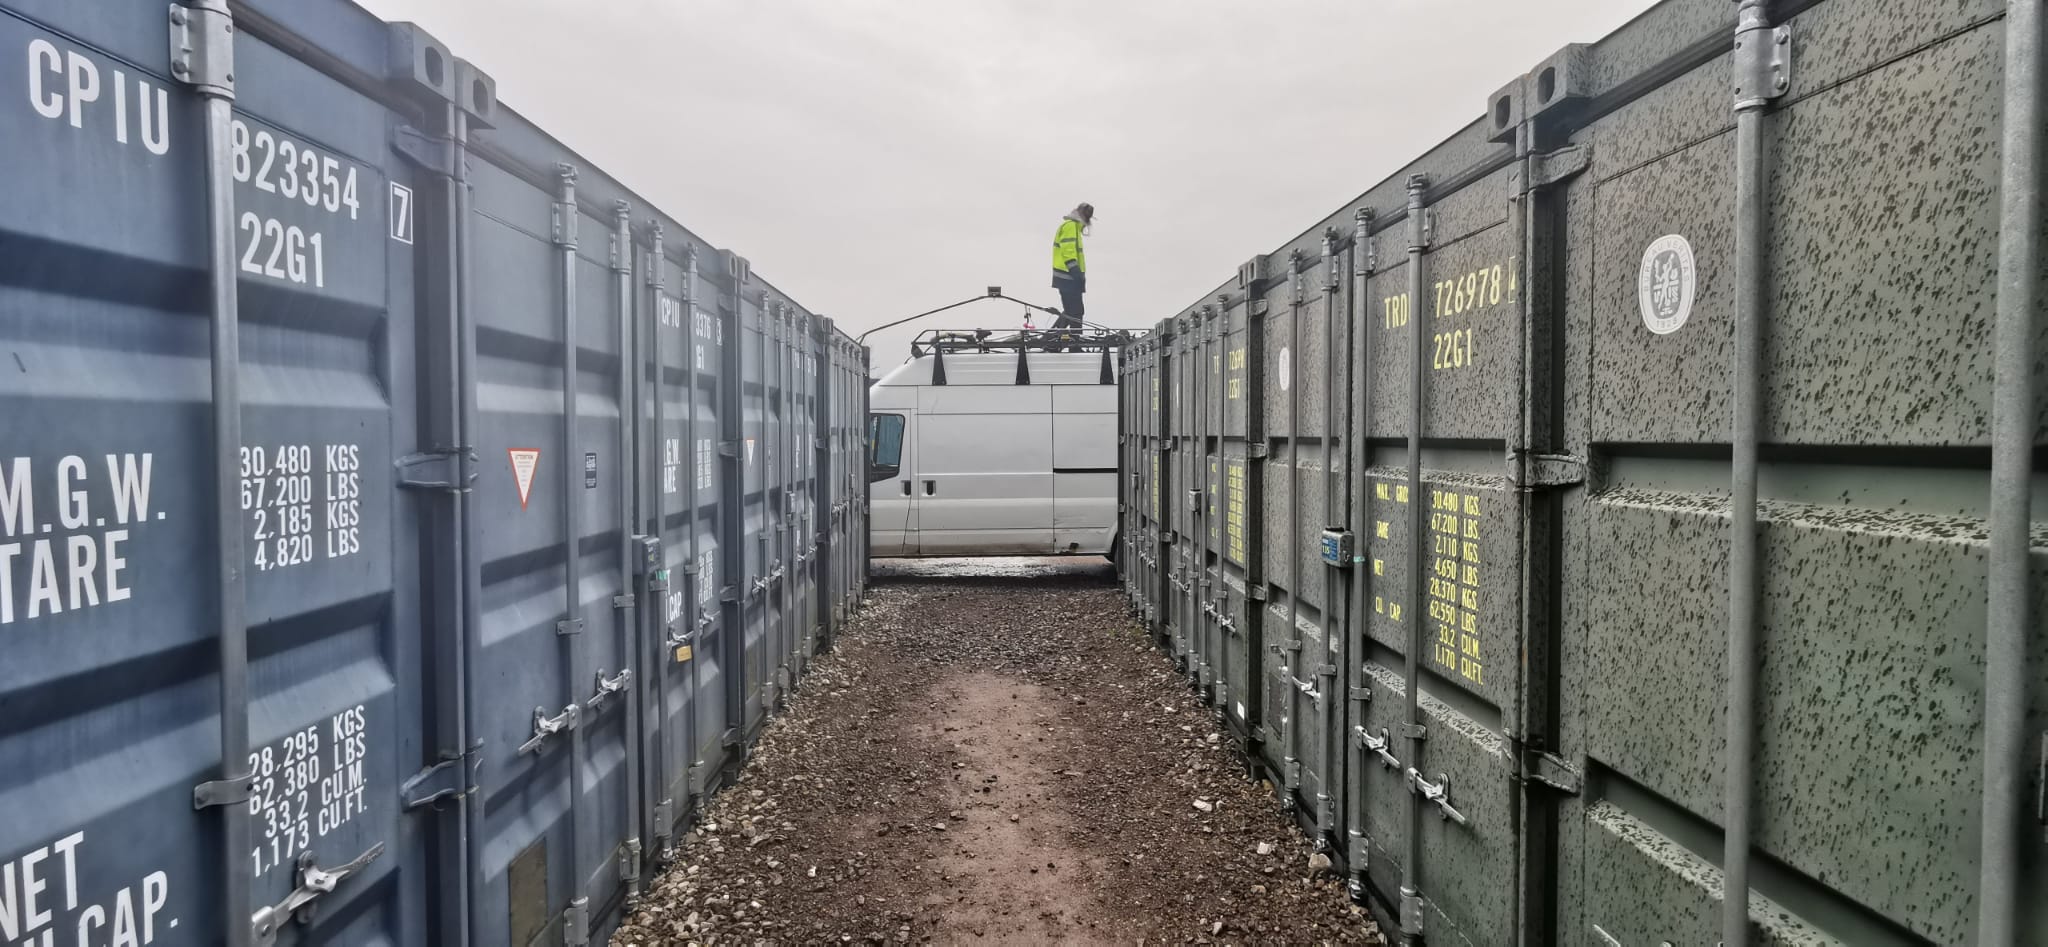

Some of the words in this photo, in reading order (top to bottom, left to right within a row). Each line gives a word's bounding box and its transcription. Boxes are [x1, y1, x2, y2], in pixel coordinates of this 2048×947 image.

[28, 38, 170, 156] CPIU
[231, 119, 360, 220] 823354
[241, 211, 324, 288] 22G1
[661, 297, 680, 329] CPIU
[1384, 291, 1411, 330] TRD
[1435, 264, 1501, 319] 726978
[1434, 328, 1473, 370] 22G1
[240, 445, 311, 477] 30,480
[326, 444, 359, 473] KGS
[0, 452, 166, 538] M.G.W.
[241, 475, 312, 511] 67,200
[326, 472, 359, 502] LBS
[1464, 494, 1481, 517] KGS.
[254, 503, 313, 541] 2,185
[326, 499, 360, 531] KGS
[1463, 518, 1480, 541] LBS.
[254, 533, 313, 572] 4,820
[327, 526, 360, 559] LBS
[1373, 558, 1384, 576] NET
[1463, 541, 1481, 564] KGS.
[0, 529, 131, 625] TARE
[1462, 564, 1480, 588] LBS.
[1389, 602, 1402, 622] CAP.
[1461, 588, 1479, 612] KGS.
[1439, 623, 1455, 648] 33.2
[1461, 634, 1481, 660] CU.M.
[1461, 611, 1479, 635] LBS.
[1461, 657, 1484, 685] CU.FT.
[249, 725, 319, 778] 28,295
[332, 704, 366, 744] KGS
[333, 731, 366, 770] LBS
[264, 790, 309, 838] 33.2
[321, 760, 367, 806] CU.M.
[251, 820, 310, 878] 1,173
[318, 786, 368, 837] CU.FT.
